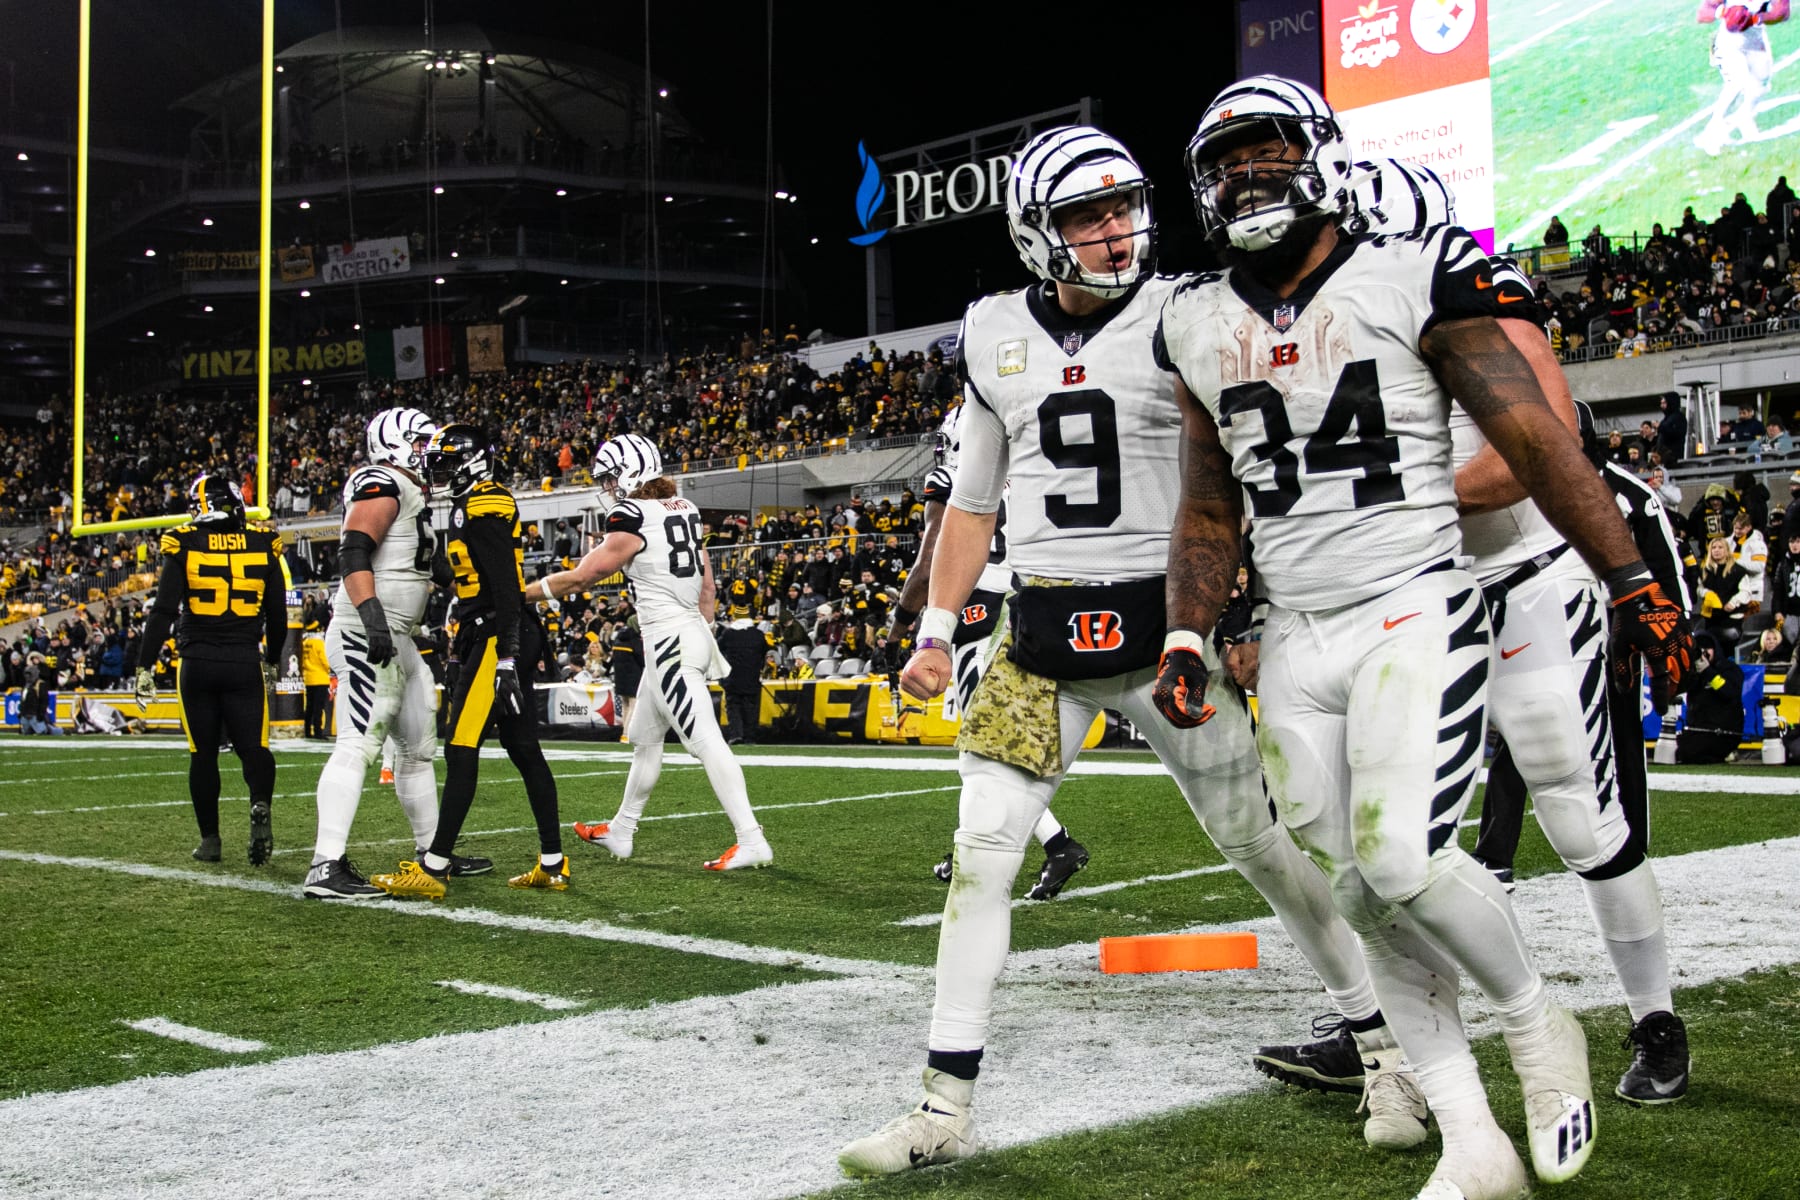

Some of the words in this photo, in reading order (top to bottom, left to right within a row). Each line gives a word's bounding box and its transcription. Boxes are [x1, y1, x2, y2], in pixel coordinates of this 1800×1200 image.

[1269, 11, 1315, 41] PNC
[1340, 11, 1399, 52] giant
[1340, 36, 1401, 68] eagle
[1361, 138, 1387, 152] the
[1394, 119, 1453, 146] official
[1402, 143, 1463, 165] market
[893, 150, 1021, 228] PEOP
[1441, 166, 1485, 183] ation
[330, 256, 391, 281] ACERO
[1218, 358, 1406, 518] 34
[1037, 388, 1121, 529] 9
[208, 534, 247, 550] BUSH
[663, 513, 705, 578] 88
[186, 551, 268, 616] 55
[1638, 611, 1678, 622] adidas
[560, 702, 588, 716] Steelers
